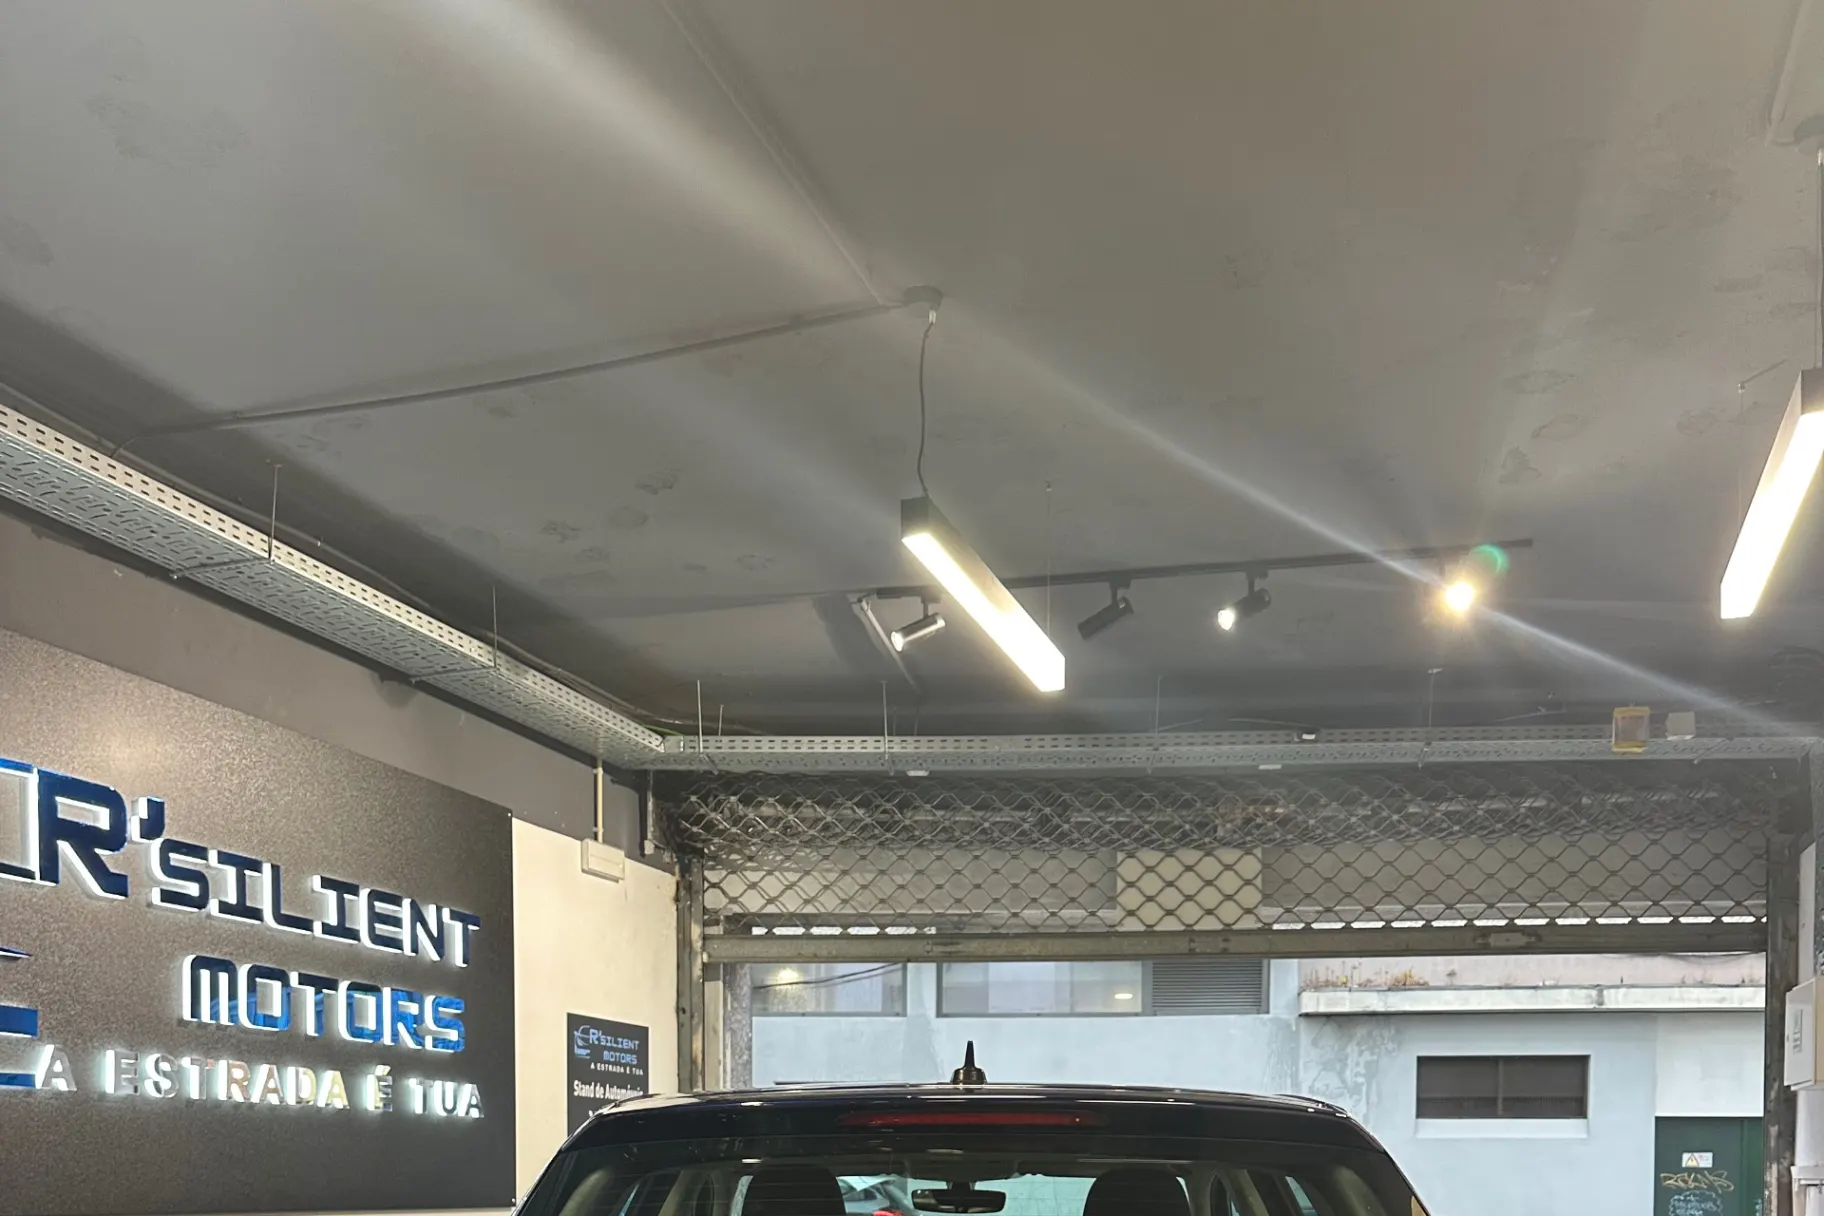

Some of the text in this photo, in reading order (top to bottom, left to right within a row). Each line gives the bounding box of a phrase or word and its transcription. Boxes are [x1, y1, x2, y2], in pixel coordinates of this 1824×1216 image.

[30, 766, 482, 968] R'SILIENT
[182, 954, 466, 1054] MOTORS
[590, 1062, 595, 1070] A
[596, 1063, 625, 1074] ESTRADA
[632, 1067, 644, 1076] TUA
[603, 1050, 638, 1065] MOTORS
[34, 1044, 485, 1119] A ESTRADA É TUA
[573, 1080, 595, 1098] Stand
[595, 1083, 605, 1099] de
